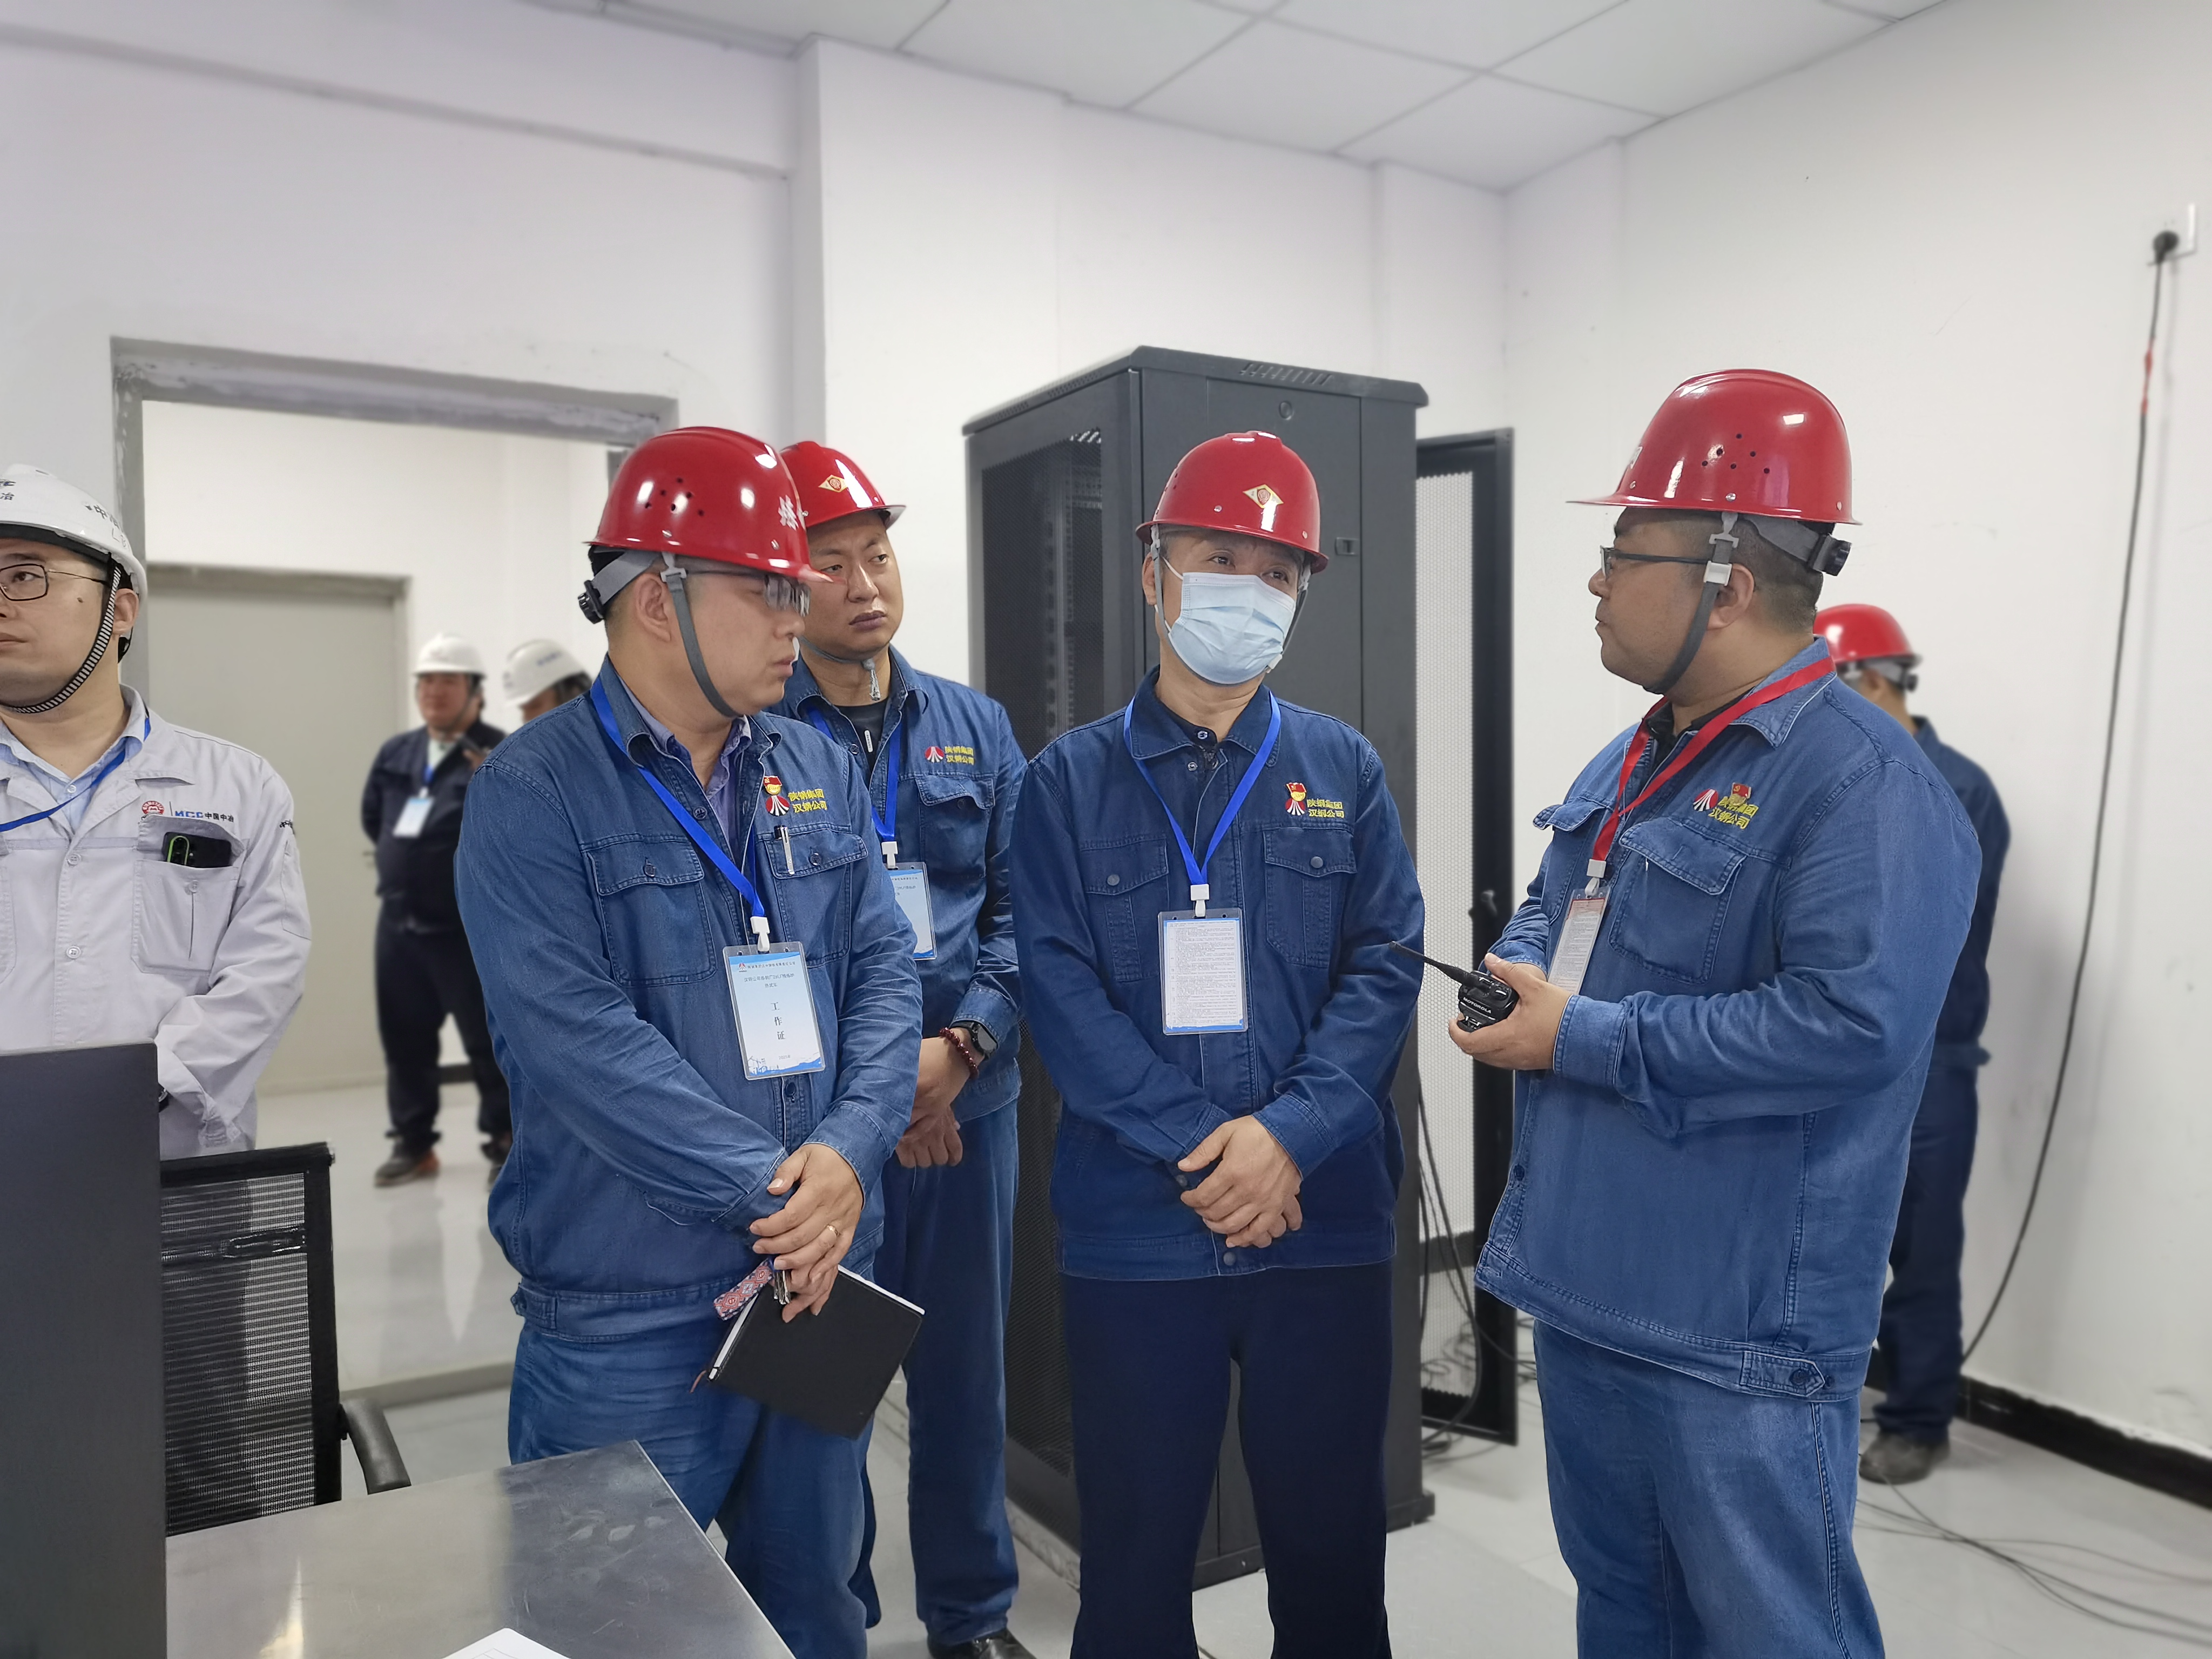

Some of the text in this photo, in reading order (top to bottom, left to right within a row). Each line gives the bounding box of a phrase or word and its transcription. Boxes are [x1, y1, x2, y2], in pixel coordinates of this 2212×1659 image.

[792, 801, 828, 813] 汉钢公司
[1306, 798, 1343, 809] 陕钢集团
[205, 812, 234, 822] 中国中冶
[1309, 809, 1345, 818] 汉钢公司
[1708, 807, 1750, 829] 汉钢公司
[1463, 997, 1492, 1014] MOTOROLA
[771, 1002, 786, 1040] 工作证
